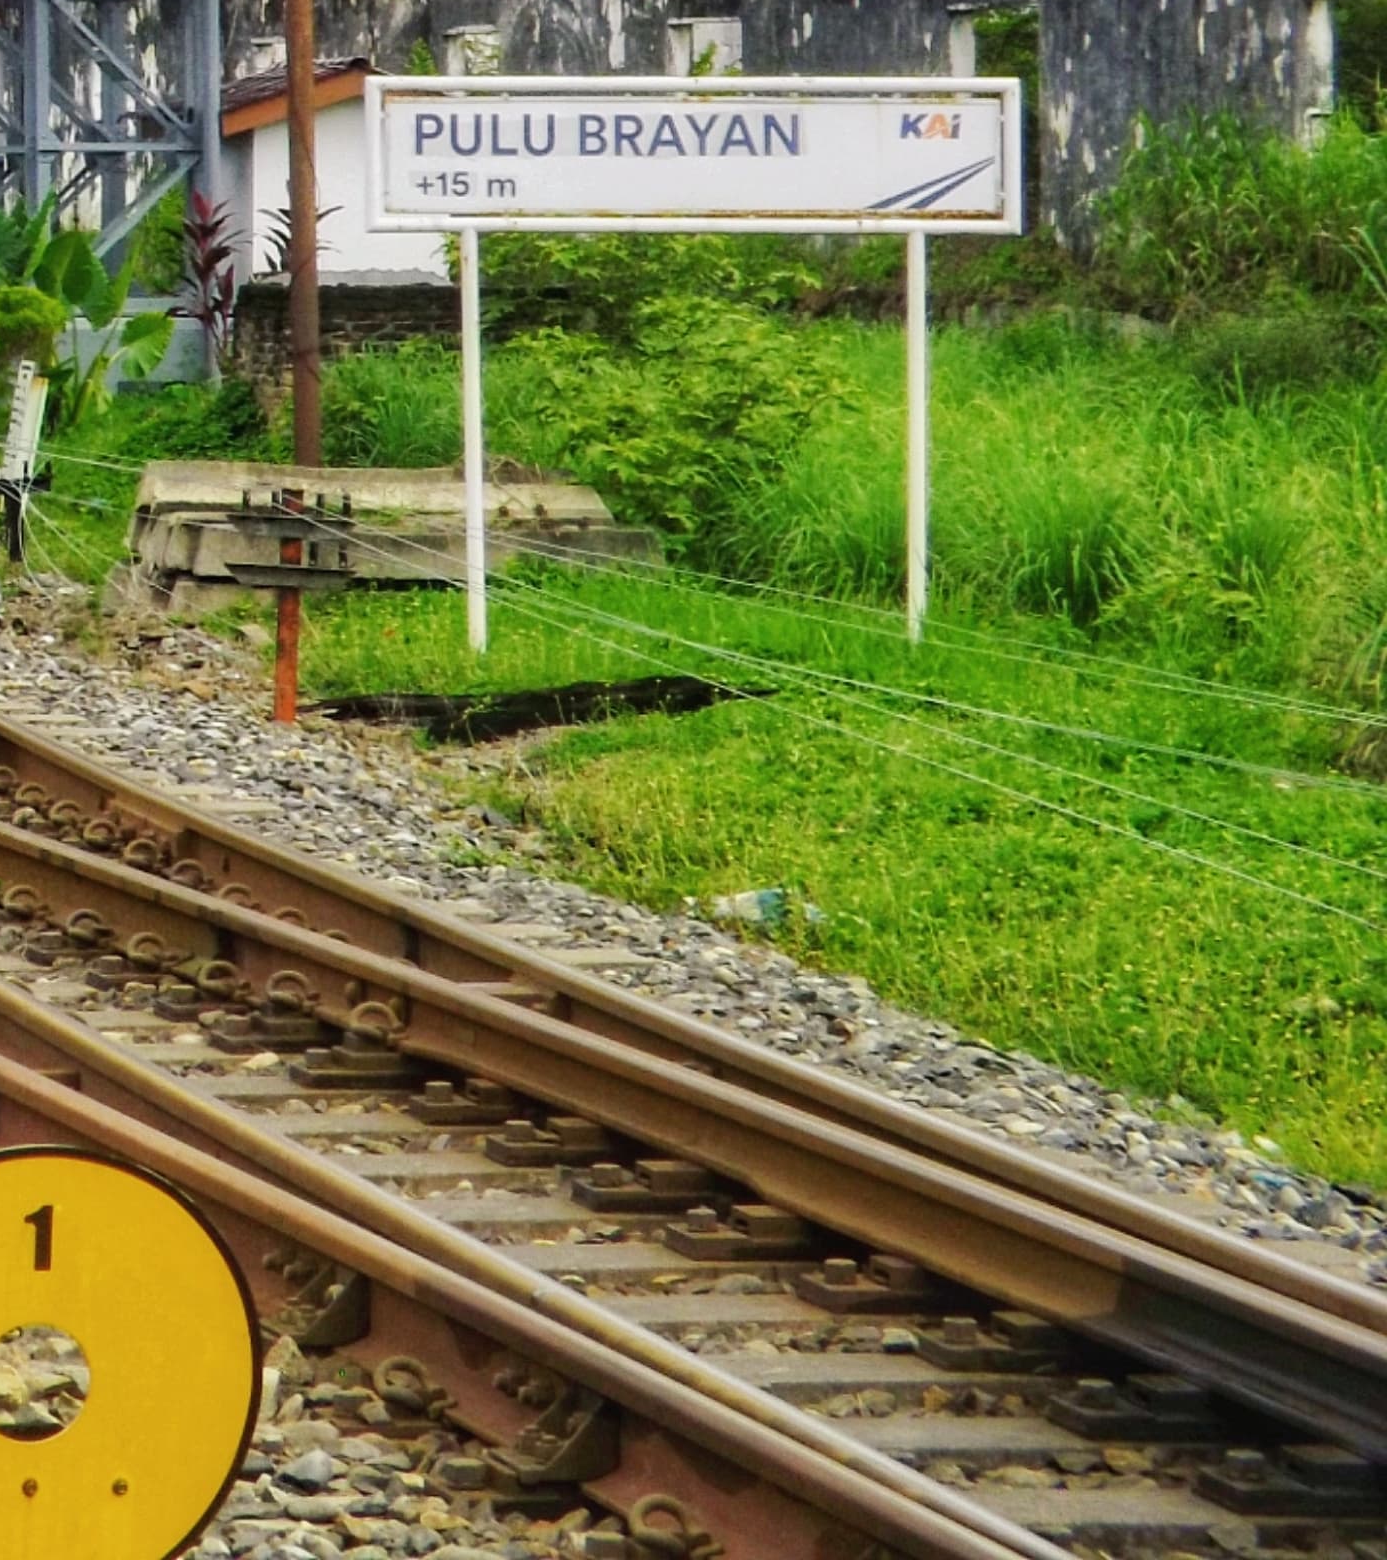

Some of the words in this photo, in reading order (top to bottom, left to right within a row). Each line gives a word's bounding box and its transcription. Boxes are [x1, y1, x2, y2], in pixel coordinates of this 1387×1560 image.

[414, 113, 556, 157] PULU
[578, 113, 800, 157] BRAYAN
[415, 171, 470, 197] +15
[486, 178, 516, 198] m
[24, 1204, 54, 1272] 1
